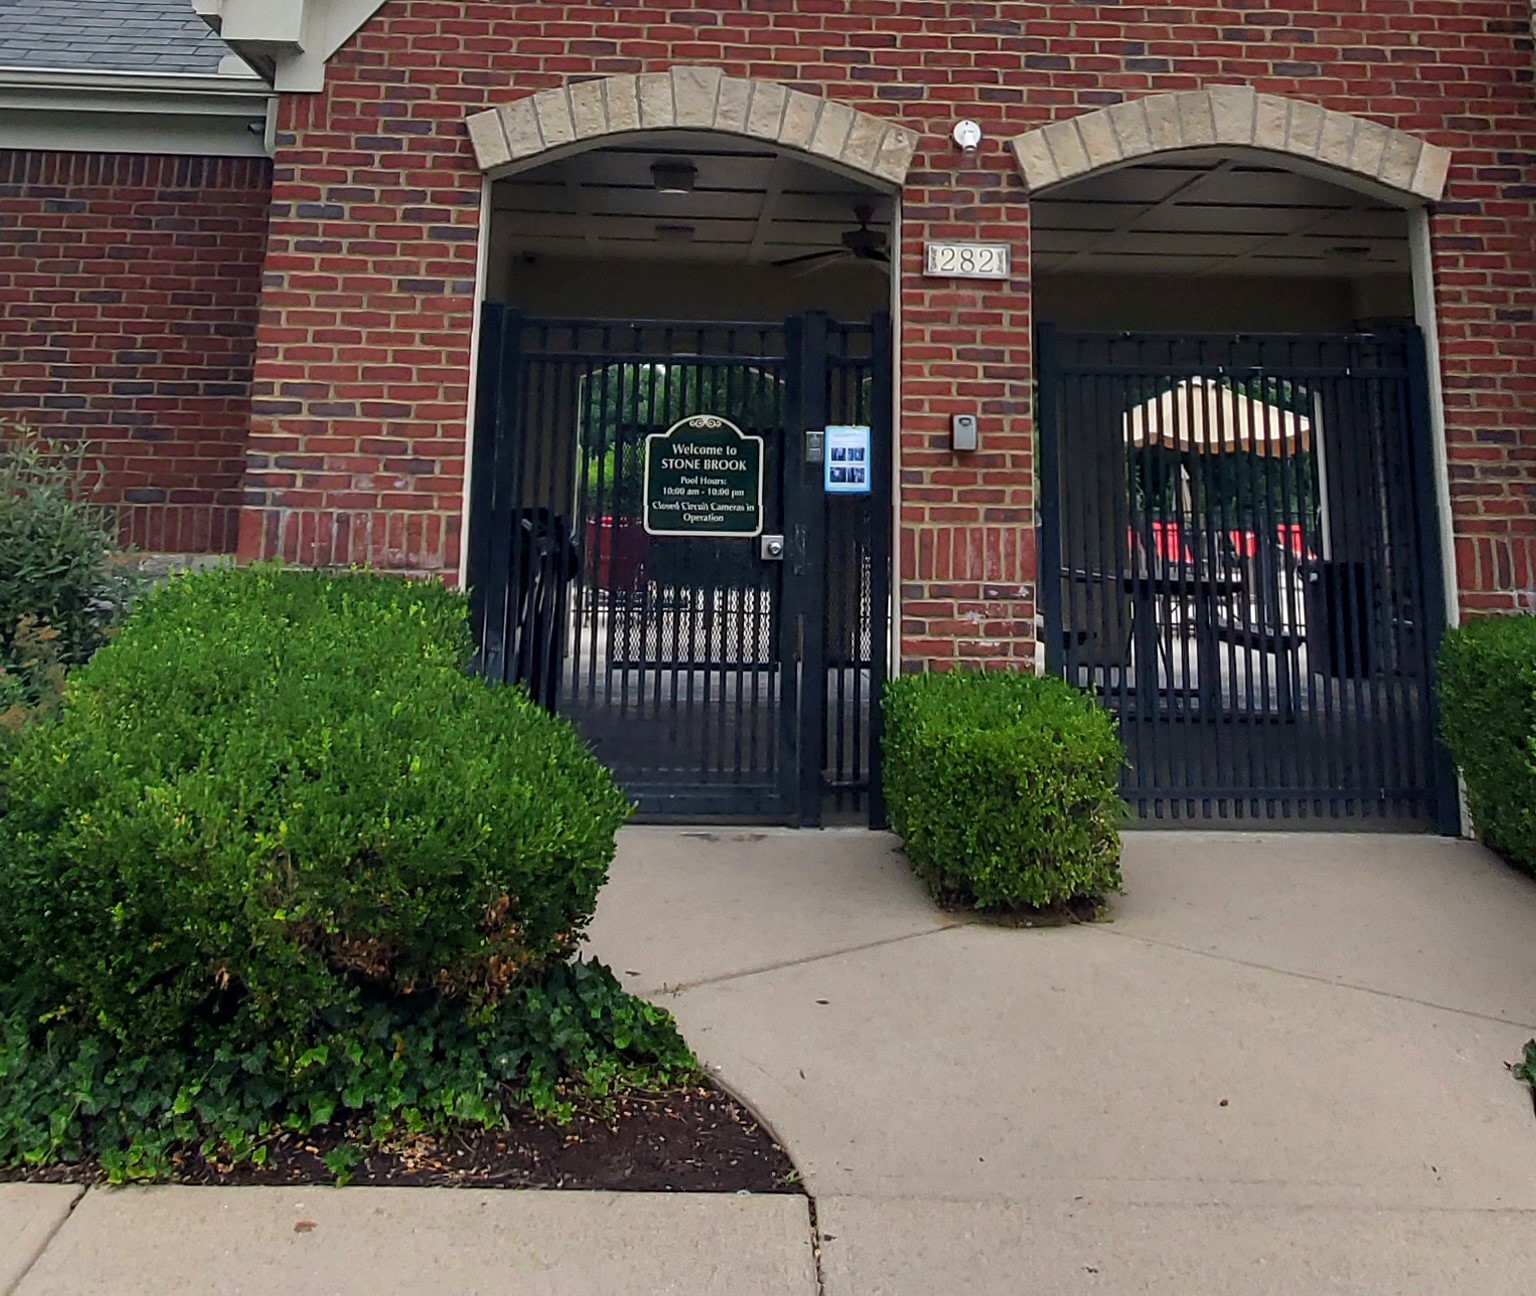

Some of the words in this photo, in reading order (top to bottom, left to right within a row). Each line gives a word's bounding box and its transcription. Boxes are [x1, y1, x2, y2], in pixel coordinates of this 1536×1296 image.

[941, 247, 993, 272] 282
[672, 443, 723, 455] Welcome
[726, 445, 737, 455] to
[661, 458, 701, 470] STONE
[704, 459, 747, 471] BROOK
[680, 476, 698, 484] Pool
[700, 476, 727, 485] Hours:
[663, 487, 685, 495] 10:00
[707, 488, 730, 496] 10:00
[731, 489, 744, 499] pm
[652, 501, 680, 510] Closed
[710, 502, 744, 511] Cameras
[746, 503, 755, 511] in
[683, 513, 724, 523] Operation
